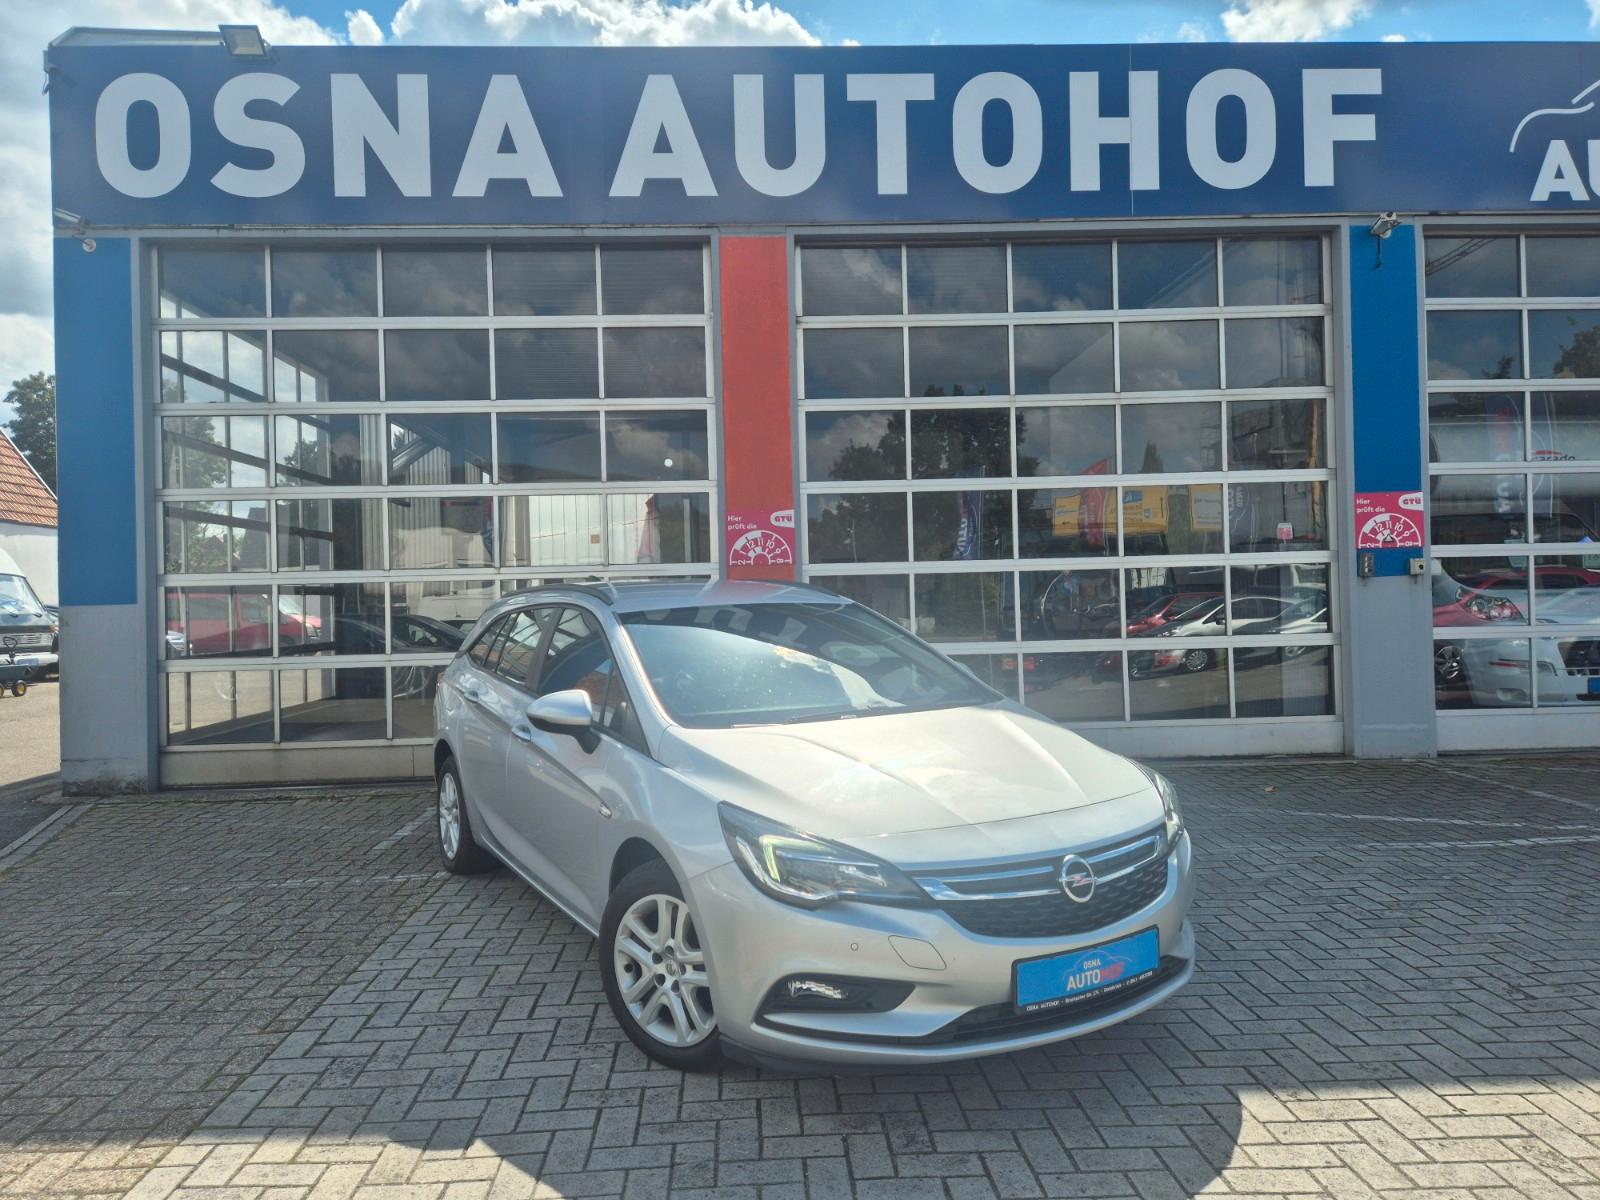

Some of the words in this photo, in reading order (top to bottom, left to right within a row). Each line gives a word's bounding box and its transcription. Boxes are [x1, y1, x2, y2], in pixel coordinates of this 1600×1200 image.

[95, 72, 563, 198] OSNA
[609, 68, 1383, 197] AUTOHOF
[1530, 139, 1600, 201] A
[1403, 497, 1422, 505] GTÜ
[1356, 506, 1374, 514] prüft
[1375, 505, 1386, 513] die
[774, 515, 793, 523] GTÜ
[727, 523, 745, 531] prüft
[1374, 523, 1385, 532] 12
[1394, 522, 1404, 532] 10
[746, 540, 756, 549] 12
[1083, 958, 1101, 970] OSNA
